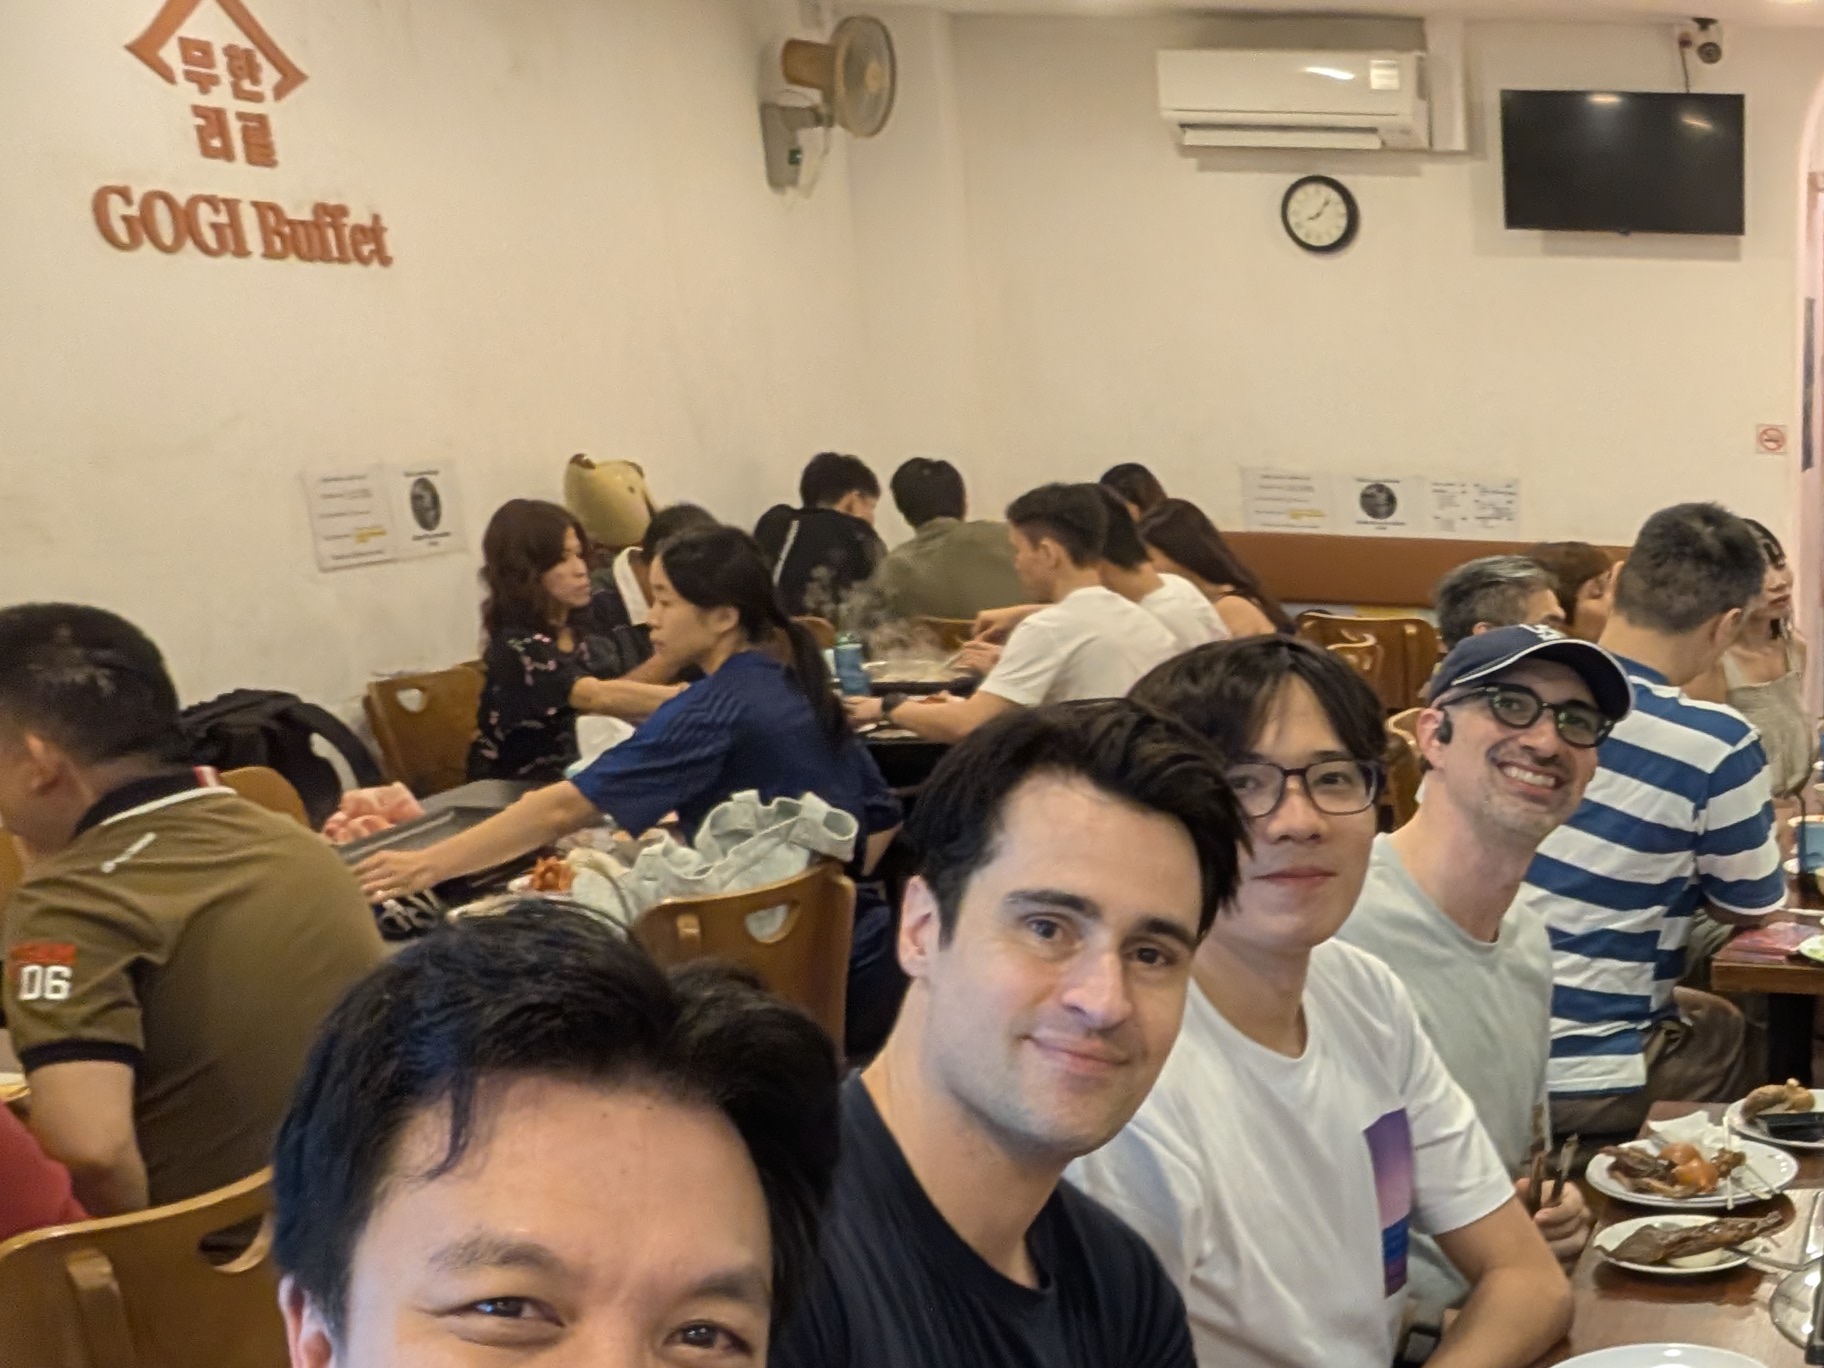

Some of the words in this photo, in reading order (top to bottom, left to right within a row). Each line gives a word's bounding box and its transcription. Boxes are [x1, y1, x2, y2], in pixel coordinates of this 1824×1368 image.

[177, 36, 266, 103] 무한
[92, 185, 252, 258] GOGI
[250, 200, 393, 267] Buffet
[19, 964, 72, 1001] 06
